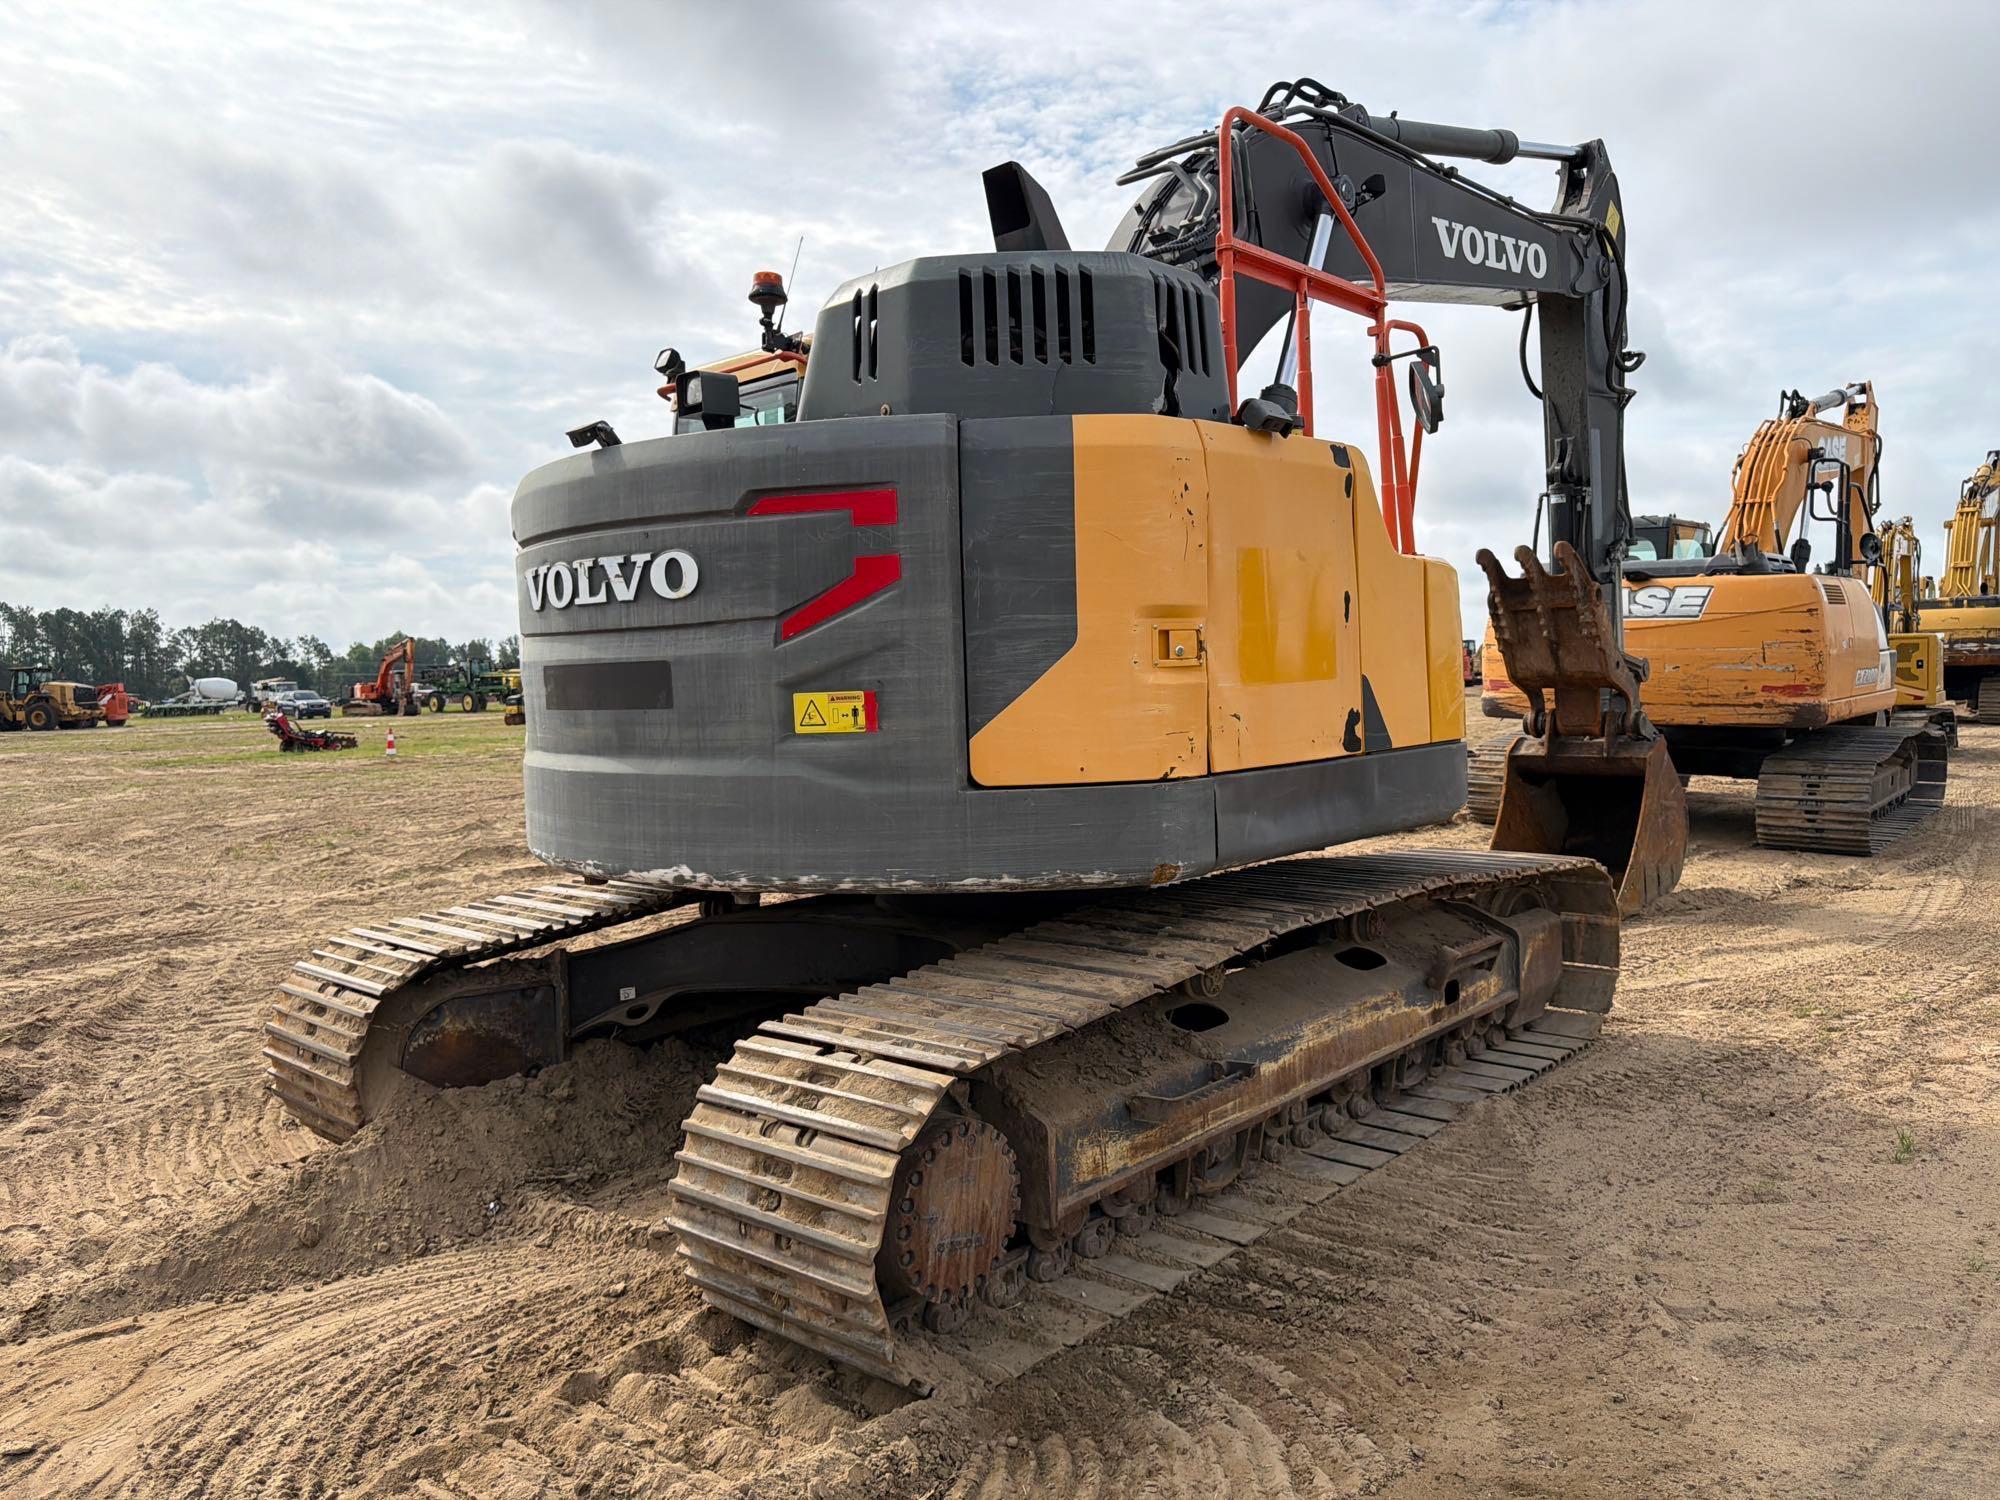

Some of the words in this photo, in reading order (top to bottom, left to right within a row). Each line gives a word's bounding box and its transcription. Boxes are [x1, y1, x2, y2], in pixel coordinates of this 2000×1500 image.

[1431, 216, 1548, 279] VOLVO
[524, 549, 699, 611] VOLVO
[1622, 586, 1714, 617] SE
